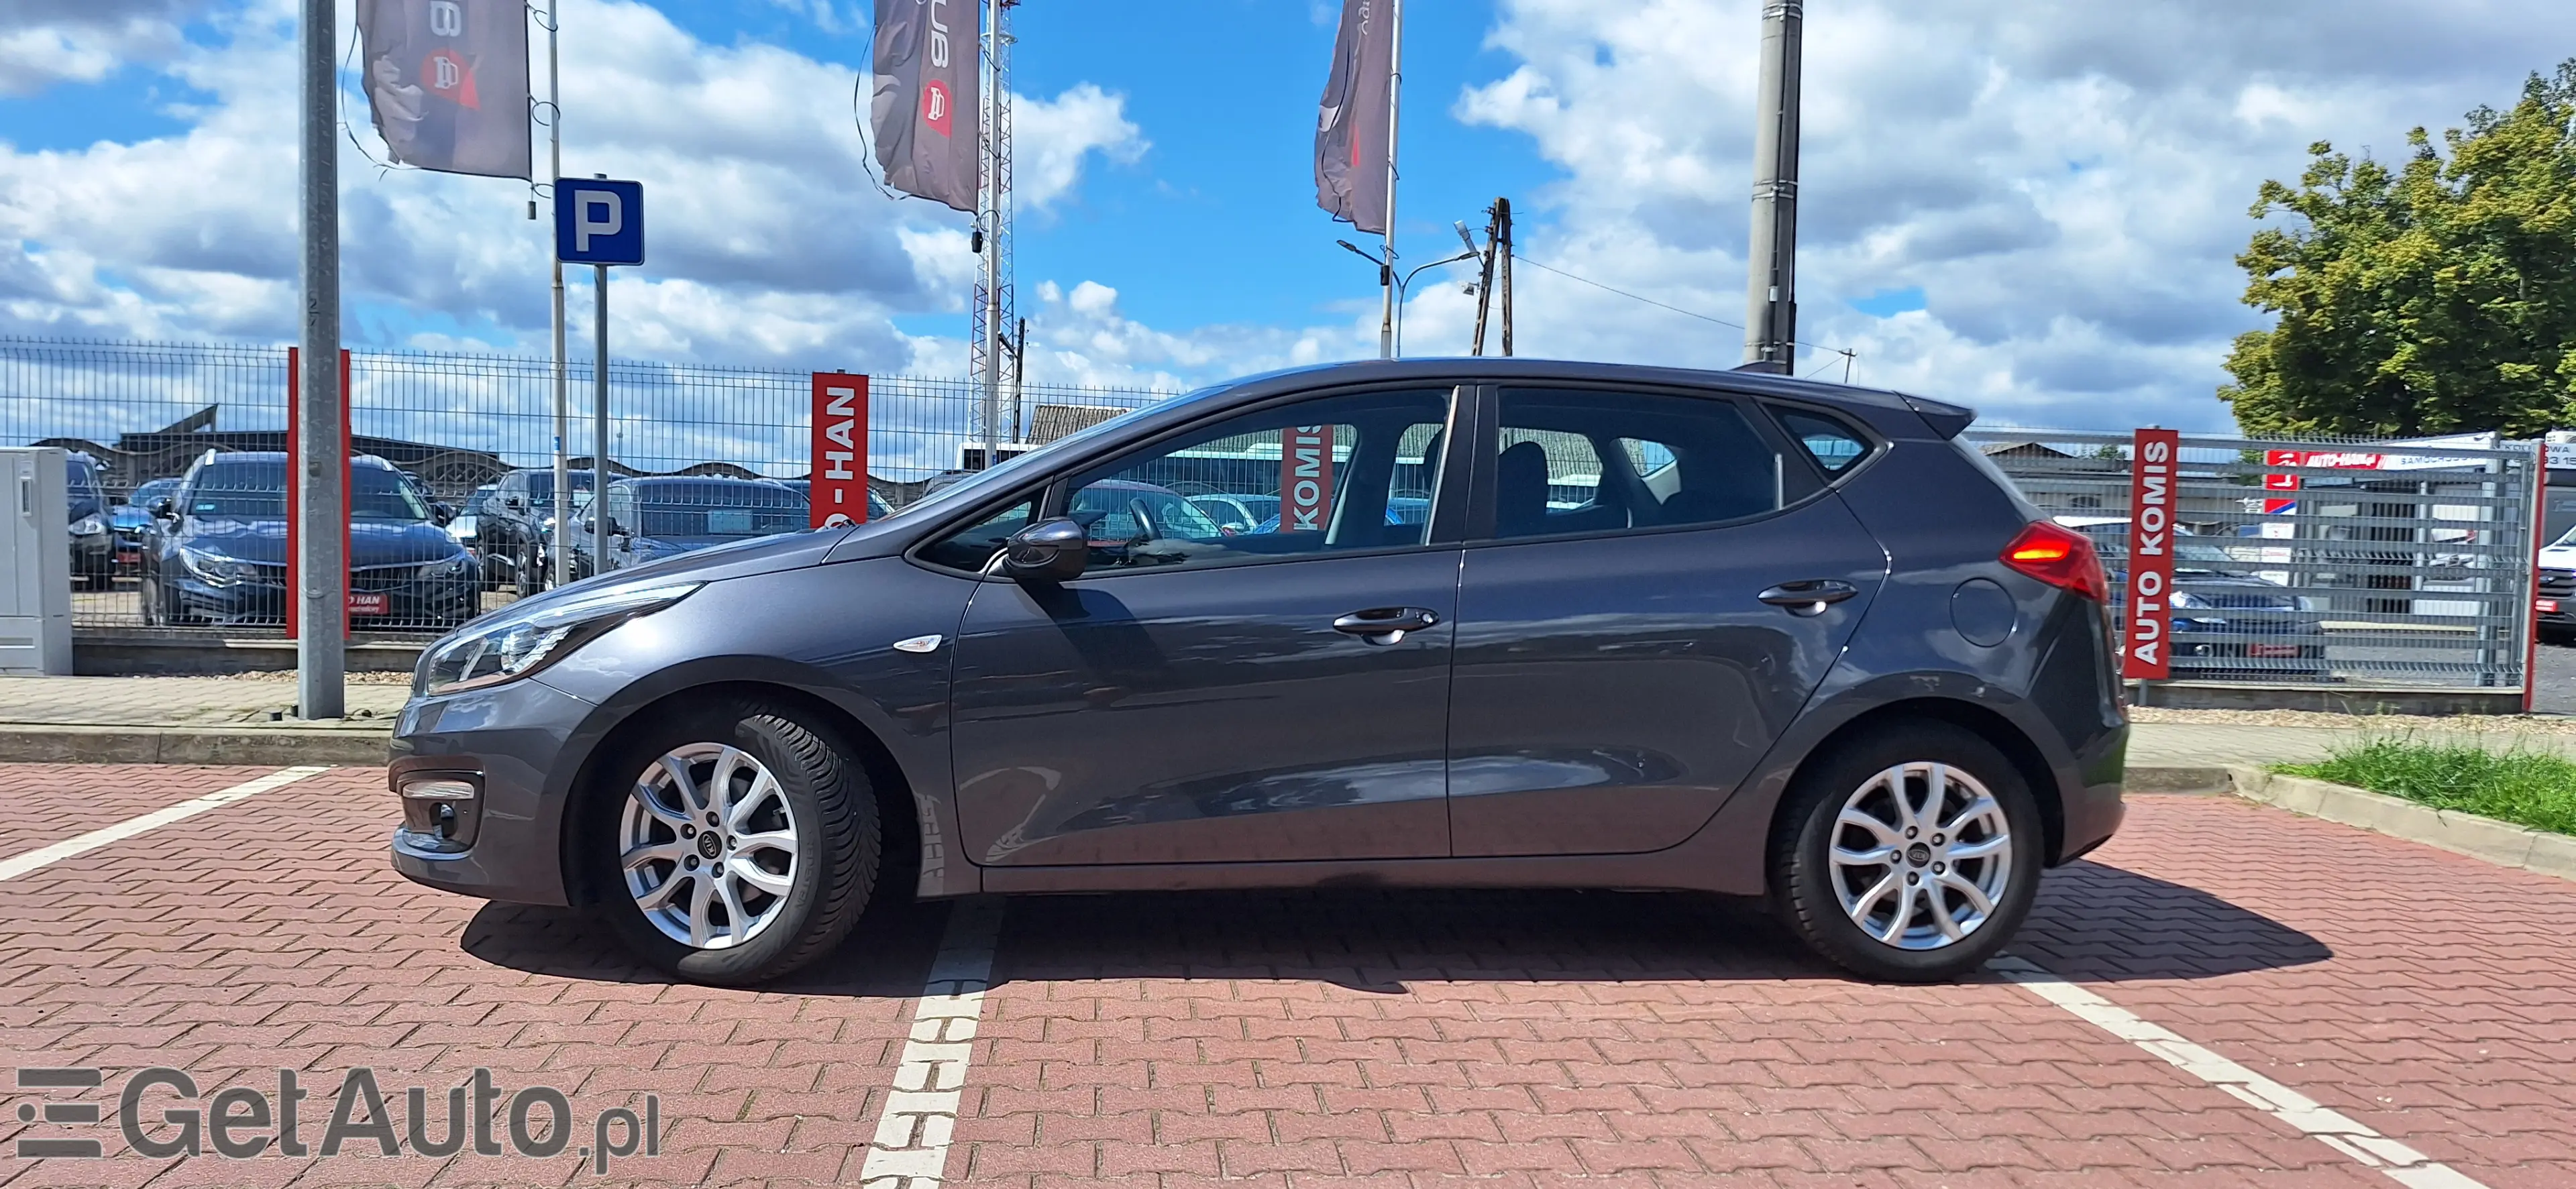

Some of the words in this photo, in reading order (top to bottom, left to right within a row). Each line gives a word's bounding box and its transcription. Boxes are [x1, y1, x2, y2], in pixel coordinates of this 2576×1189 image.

[575, 190, 622, 252] P
[2139, 441, 2169, 555] KOMIS
[356, 596, 380, 604] HAN
[2134, 571, 2162, 665] AUTO
[704, 836, 715, 854] KIA
